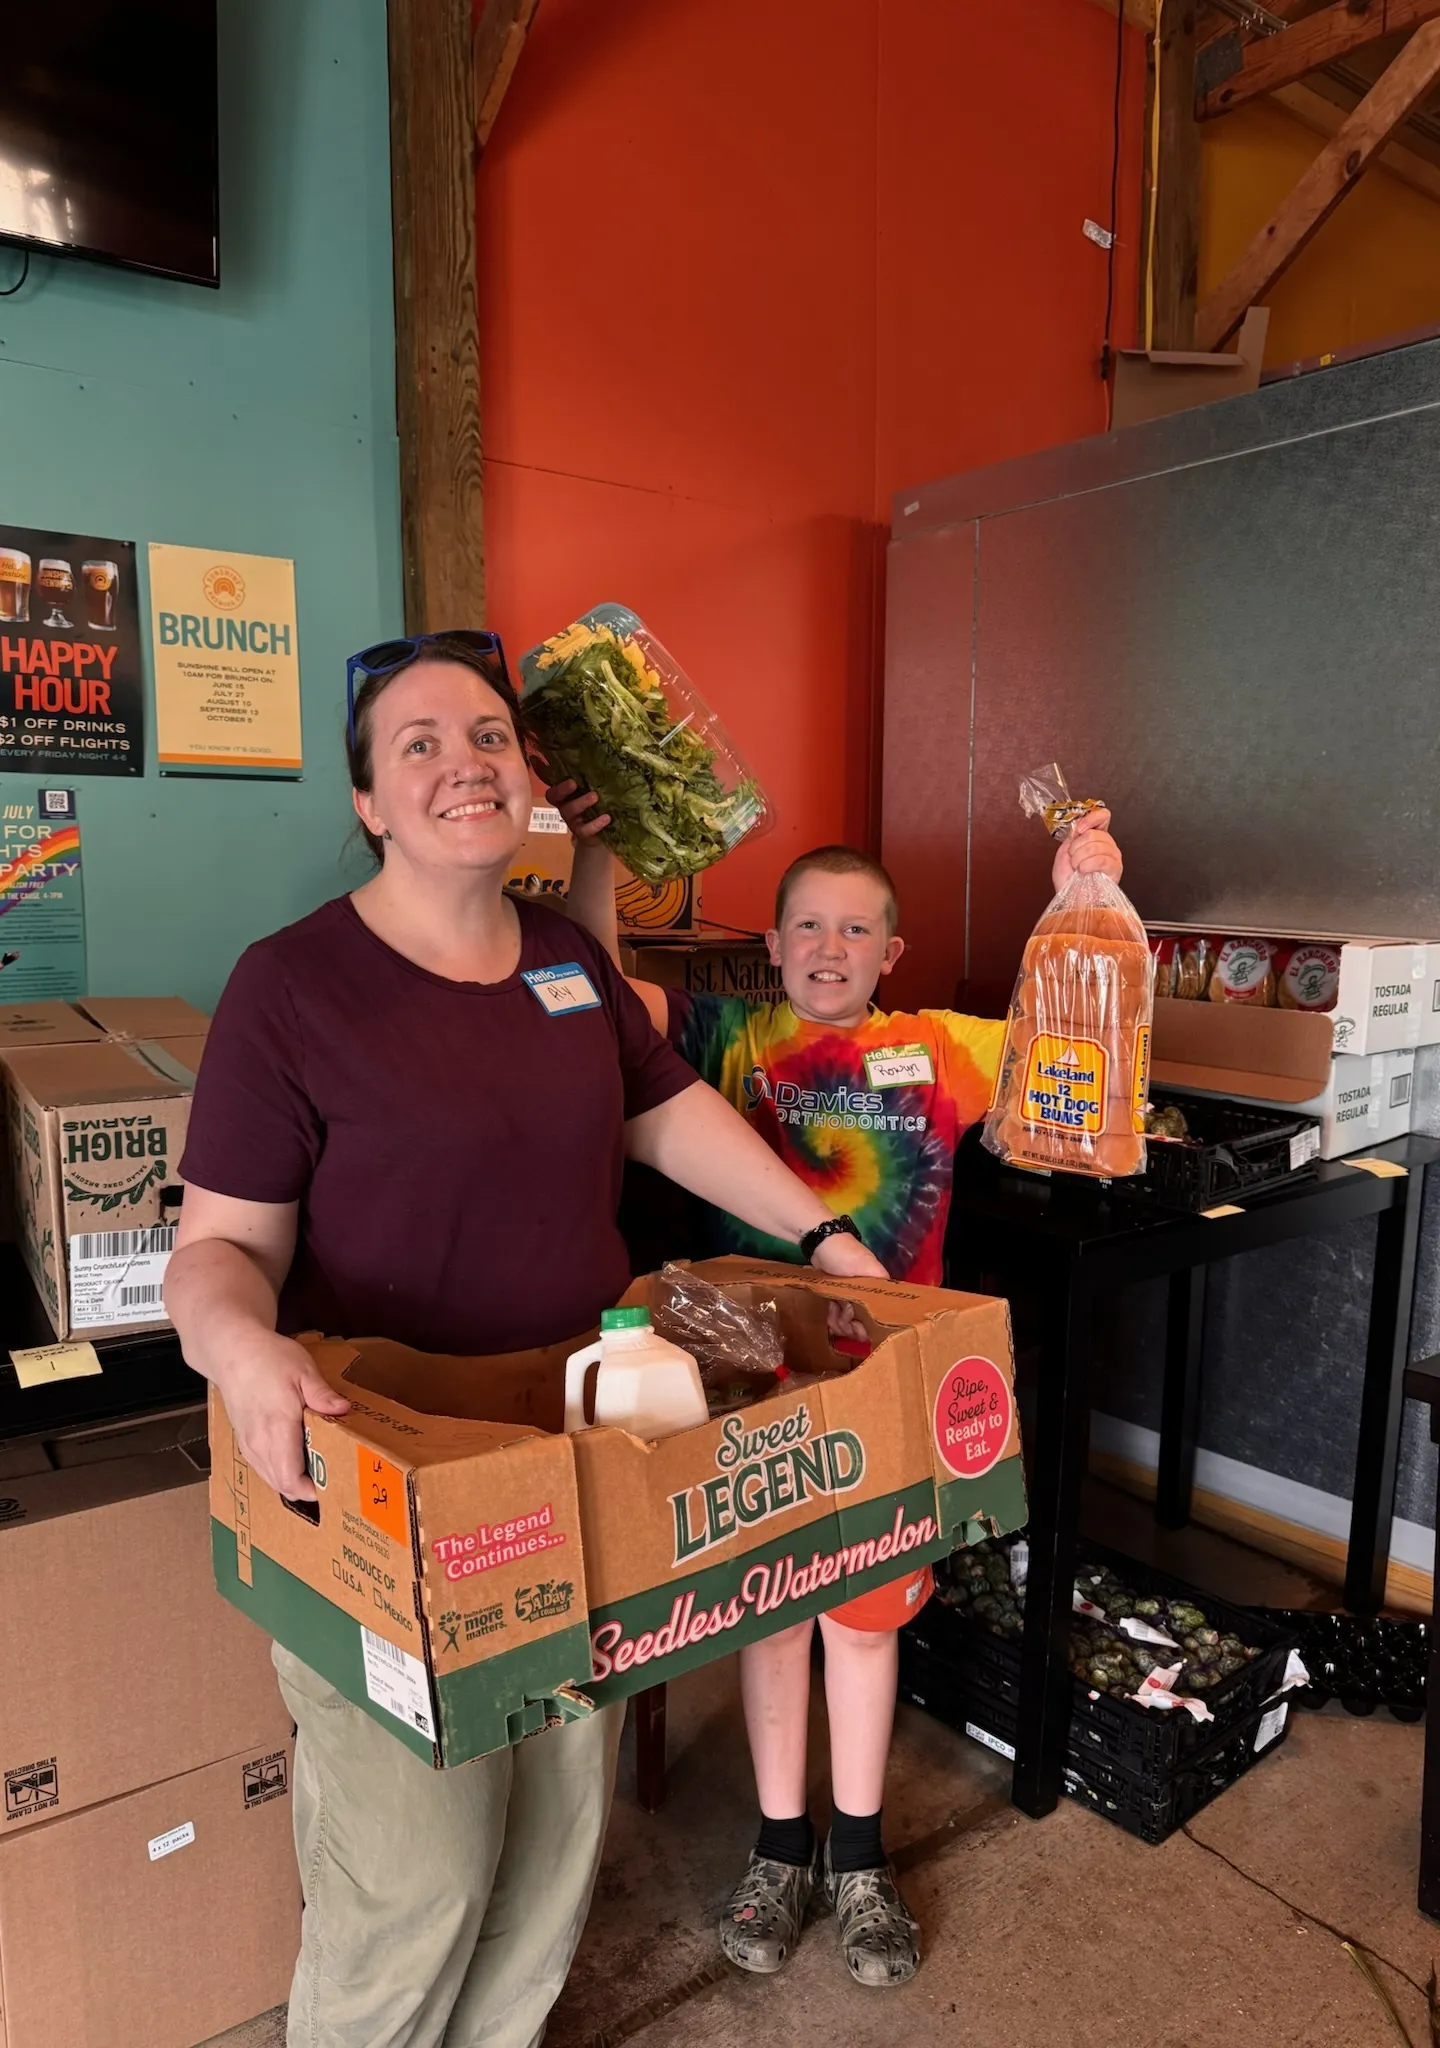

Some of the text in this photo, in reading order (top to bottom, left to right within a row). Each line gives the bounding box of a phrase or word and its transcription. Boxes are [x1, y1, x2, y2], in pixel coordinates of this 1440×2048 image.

[159, 612, 291, 656] BRUNCH
[1, 636, 118, 679] HAPPY
[177, 662, 219, 671] SUNSHINE
[221, 665, 240, 673] WILL
[242, 667, 264, 675] OPEN
[224, 674, 259, 683] BRUNCH
[15, 674, 112, 715] HOUR
[206, 698, 240, 707] AUGUST
[199, 706, 247, 715] SEPTEMBER
[206, 715, 246, 723] OCTOBER
[0, 716, 126, 733] $1 OFF DRINKS
[21, 735, 54, 746] OFF
[60, 737, 130, 750] FLIGHTS
[0, 749, 35, 757] EVERY
[38, 750, 76, 759] FRIDAY
[78, 752, 110, 760] NIGHT
[2, 805, 34, 819] JULY
[4, 825, 52, 839] FOR
[0, 863, 78, 877] PARTY
[1220, 939, 1267, 963] EL RANCHERO
[1289, 949, 1337, 977] EL RANCHERO
[523, 969, 556, 984] Hello
[1374, 983, 1412, 998] TOSTADA
[1372, 1002, 1409, 1018] REGULAR
[1038, 1062, 1095, 1083] Lakeland
[774, 1081, 883, 1114] Davies
[1057, 1083, 1071, 1097] 12
[1338, 1085, 1371, 1105] TOSTADA
[1028, 1090, 1099, 1114] HOT DOG
[63, 1115, 152, 1132] FARMS
[776, 1107, 927, 1132] ORTHODONTICS
[1040, 1106, 1084, 1126] BUNS
[1336, 1104, 1369, 1124] REGULAR
[63, 1127, 167, 1164] BRIGH
[126, 1165, 147, 1183] SALAD
[74, 1265, 92, 1273] Sunny
[884, 1290, 920, 1299] KEEP
[952, 1376, 989, 1401] Ripe,
[948, 1392, 999, 1427] Sweet &
[717, 1404, 809, 1468] Sweet
[945, 1413, 1003, 1447] Ready to
[965, 1438, 991, 1461] Eat.
[668, 1429, 865, 1567] LEGEND
[434, 1506, 552, 1560] The Legend
[446, 1534, 565, 1579] Continues...
[342, 1544, 396, 1593] PRODUCE OF
[342, 1568, 366, 1597] U.S.A.
[591, 1505, 938, 1681] Seedless Watermelon
[382, 1599, 413, 1632] Mexico
[464, 1608, 504, 1632] more
[987, 1735, 1006, 1751] IFCO
[36, 1759, 49, 1768] THIS
[242, 1749, 286, 1771] DO NOT CLAMP
[4, 1763, 36, 1778] DIRECTION
[262, 1788, 288, 1803] DIRECTION
[6, 1798, 59, 1820] DO NOT CLAMP
